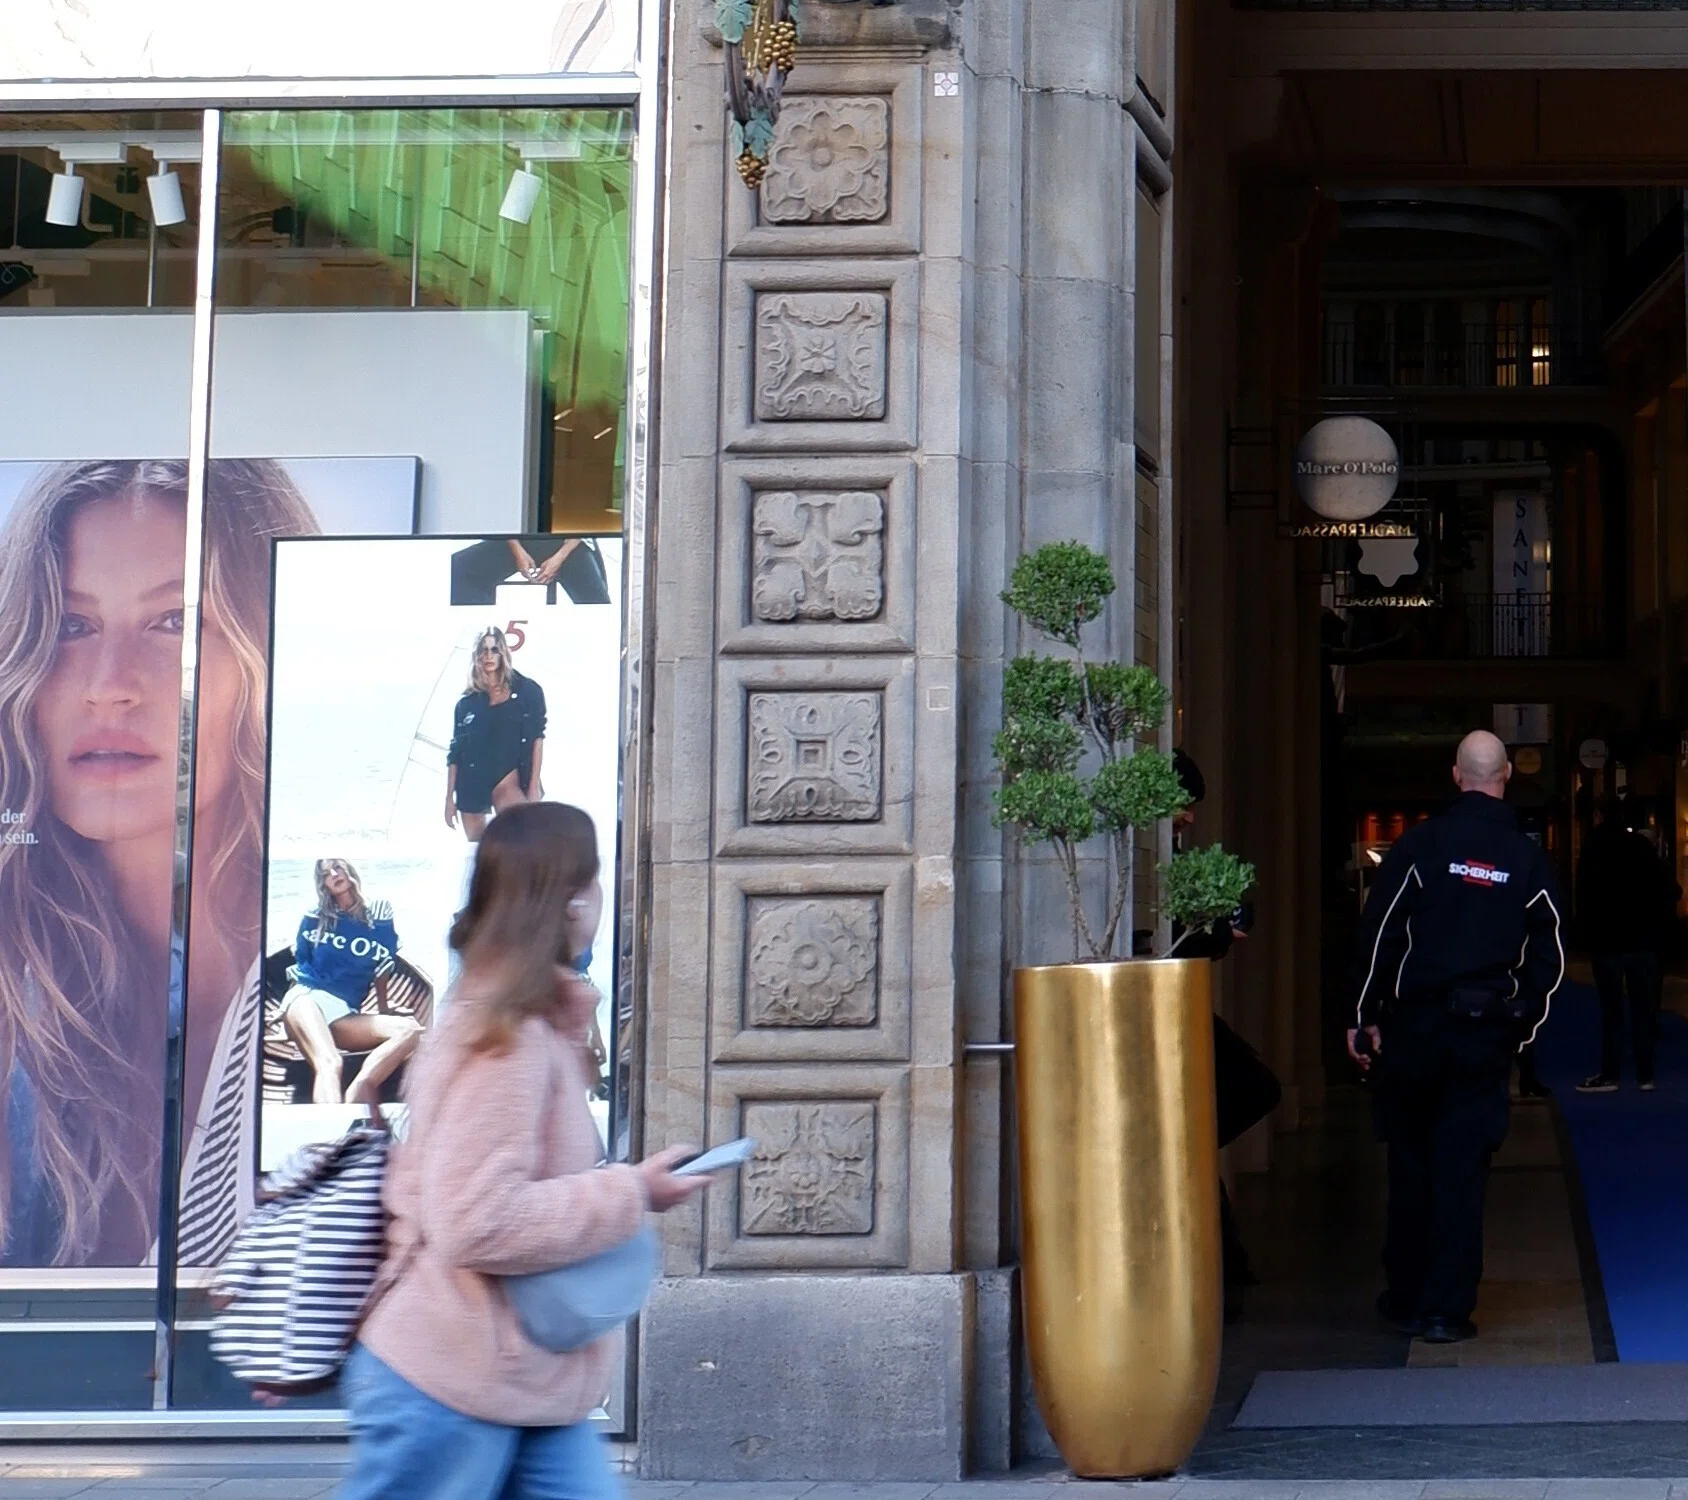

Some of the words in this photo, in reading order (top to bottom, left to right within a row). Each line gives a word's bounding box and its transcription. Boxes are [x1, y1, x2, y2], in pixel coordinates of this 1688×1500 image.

[1297, 462, 1341, 474] Marc
[1344, 461, 1398, 474] O'Polo
[4, 830, 39, 845] sein.
[1448, 862, 1511, 884] SICHERHEIT
[302, 929, 347, 949] arc
